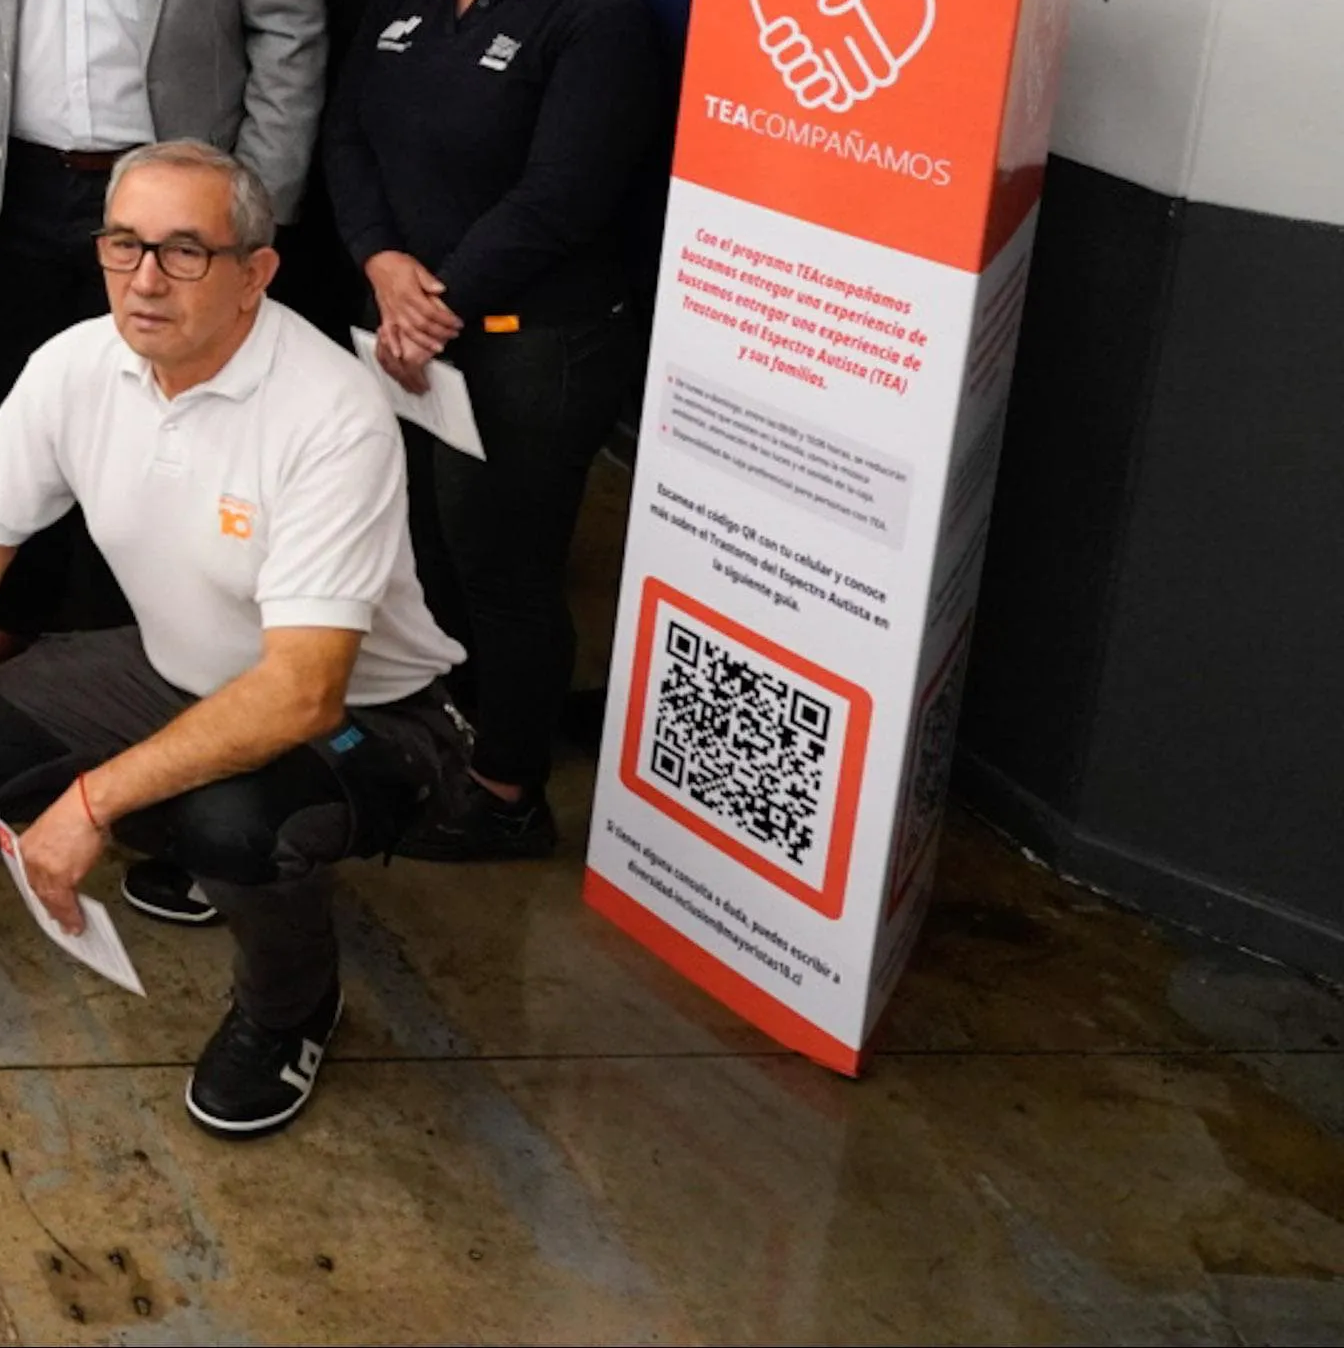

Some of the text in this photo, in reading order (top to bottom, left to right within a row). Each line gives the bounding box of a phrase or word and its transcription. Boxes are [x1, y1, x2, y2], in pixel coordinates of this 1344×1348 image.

[704, 94, 951, 186] TEACOMPAÑAMOS
[681, 246, 928, 347] buscamos entregar una experiencia de
[696, 228, 912, 315] Con el programa TEAcompañamos
[677, 268, 922, 372] buscamos entregar una experiencia de
[683, 294, 909, 396] Trastorno del Espectro Autista (TEA)
[737, 345, 748, 360] y
[749, 349, 770, 367] sus
[221, 511, 253, 539] 10
[670, 513, 698, 536] sobre
[699, 528, 708, 541] el
[709, 532, 759, 567] Trastorno
[760, 559, 778, 576] del
[778, 567, 826, 600] Espectro
[828, 592, 872, 622] Autista
[873, 615, 890, 631] en
[696, 504, 705, 517] el
[707, 508, 741, 534] código
[742, 525, 758, 540] QR
[758, 534, 778, 552] con
[779, 544, 793, 559] tu
[794, 552, 833, 577] celular
[834, 570, 843, 585] y
[844, 574, 886, 603] conoce
[724, 564, 771, 598] siguiente
